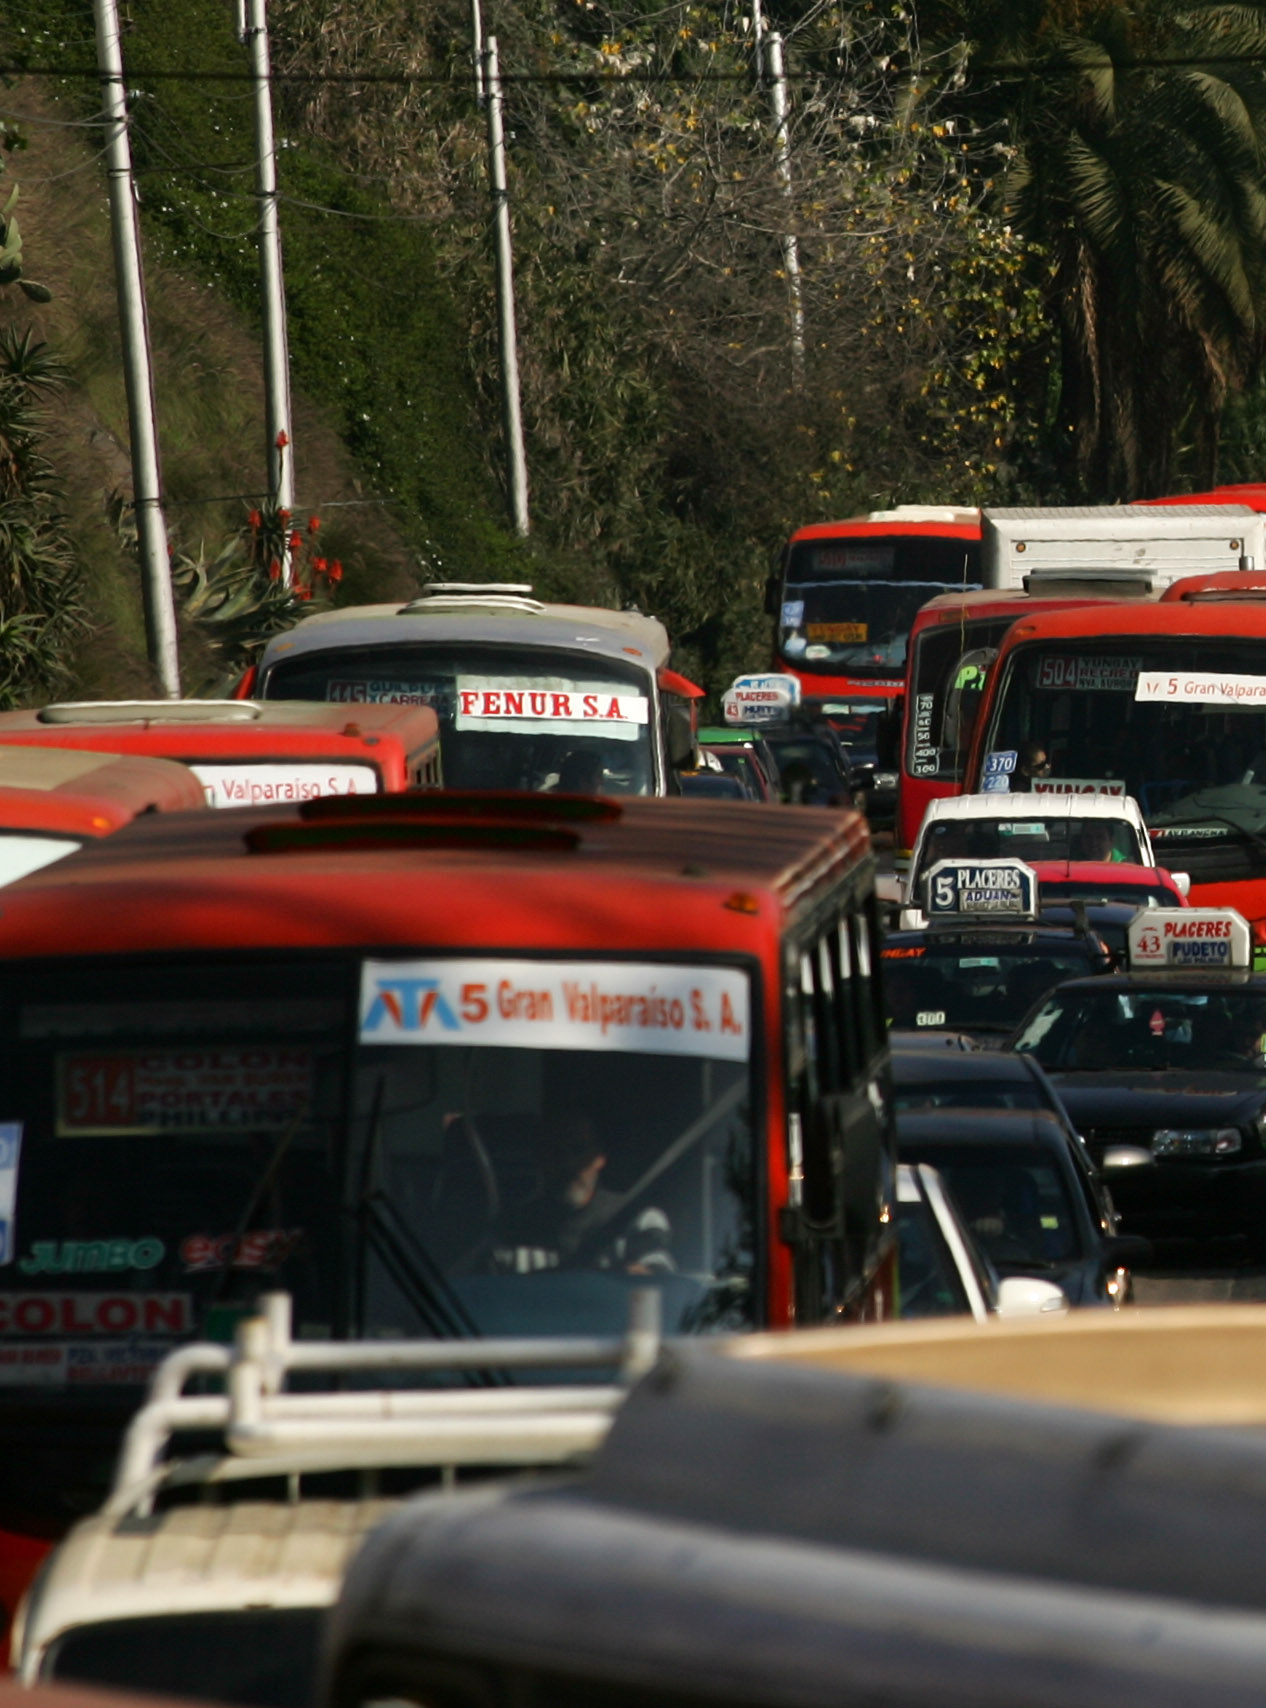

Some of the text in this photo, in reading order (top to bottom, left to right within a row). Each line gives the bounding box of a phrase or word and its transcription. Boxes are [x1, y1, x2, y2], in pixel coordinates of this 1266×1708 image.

[1042, 658, 1076, 686] 504
[1081, 657, 1140, 668] YUNGAY
[1167, 678, 1178, 695] 5
[1184, 681, 1216, 696] Gran
[460, 691, 629, 719] FENUR S.A.
[989, 757, 1013, 772] 370
[935, 868, 1020, 908] 5 PLACERES
[1164, 920, 1232, 938] PLACERES
[1137, 935, 1161, 953] 43
[1173, 941, 1228, 957] PUDETO
[460, 983, 489, 1024] 5
[496, 979, 554, 1022] Gran
[19, 1236, 165, 1275] JUMBO
[0, 1297, 184, 1333] OLON
